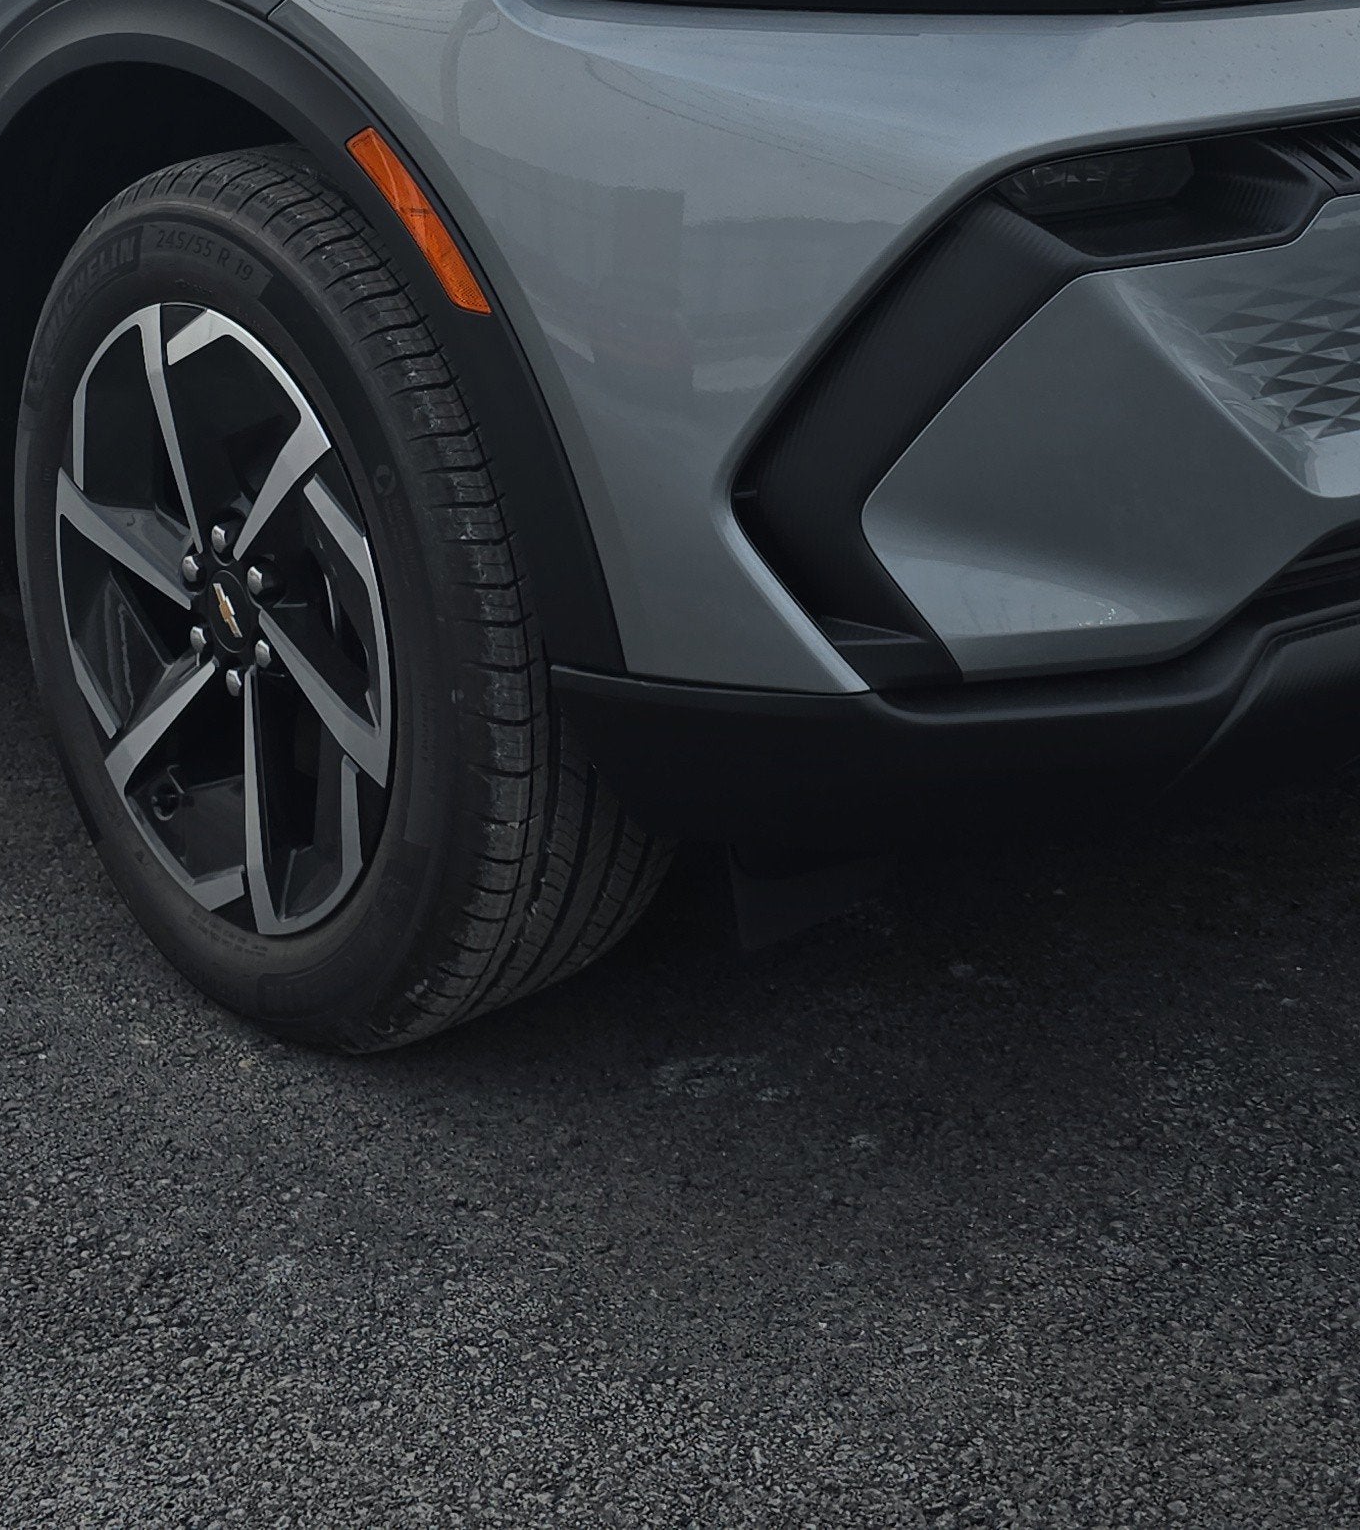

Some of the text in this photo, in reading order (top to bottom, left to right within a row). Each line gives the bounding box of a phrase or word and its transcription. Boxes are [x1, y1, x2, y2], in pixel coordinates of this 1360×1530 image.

[157, 229, 254, 282] 245/55 R 19
